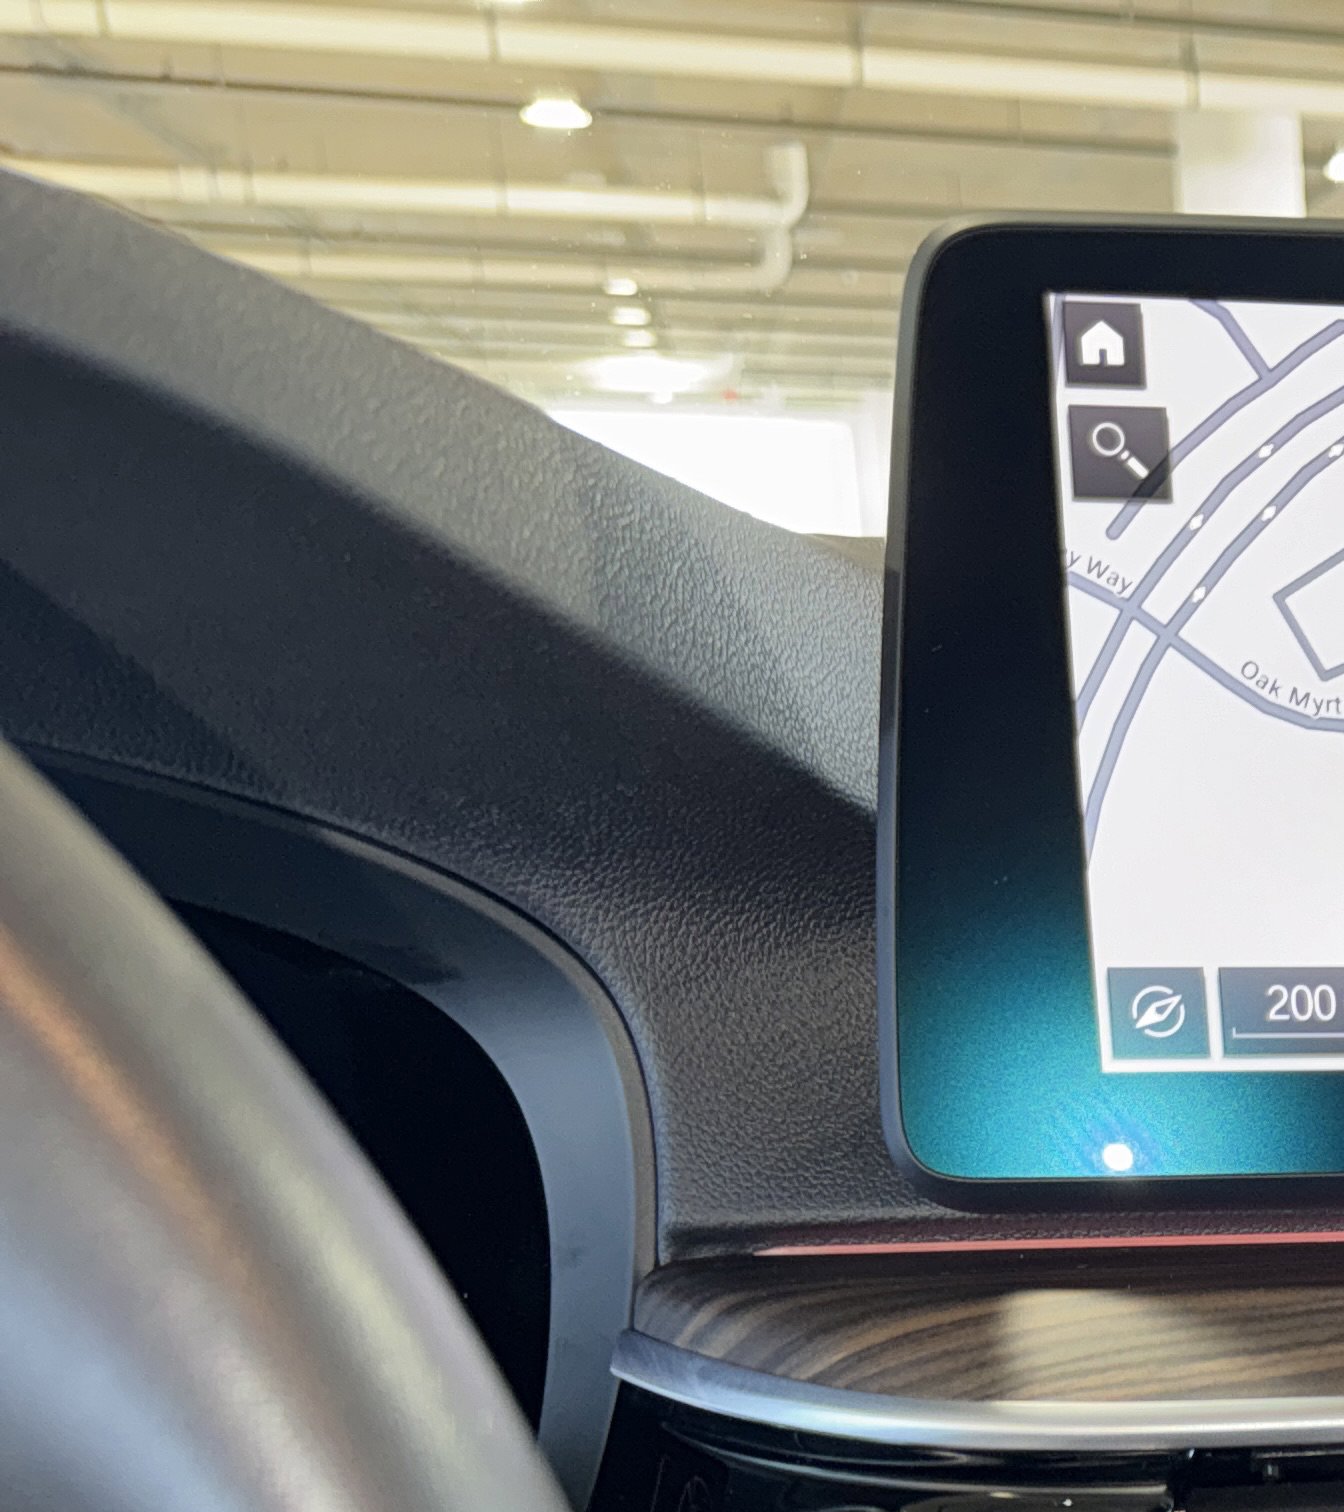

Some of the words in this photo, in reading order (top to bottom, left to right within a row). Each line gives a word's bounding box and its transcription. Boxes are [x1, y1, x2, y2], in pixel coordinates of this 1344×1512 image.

[1087, 555, 1133, 595] Way
[1240, 660, 1283, 698] Oak
[1266, 984, 1336, 1022] 200
